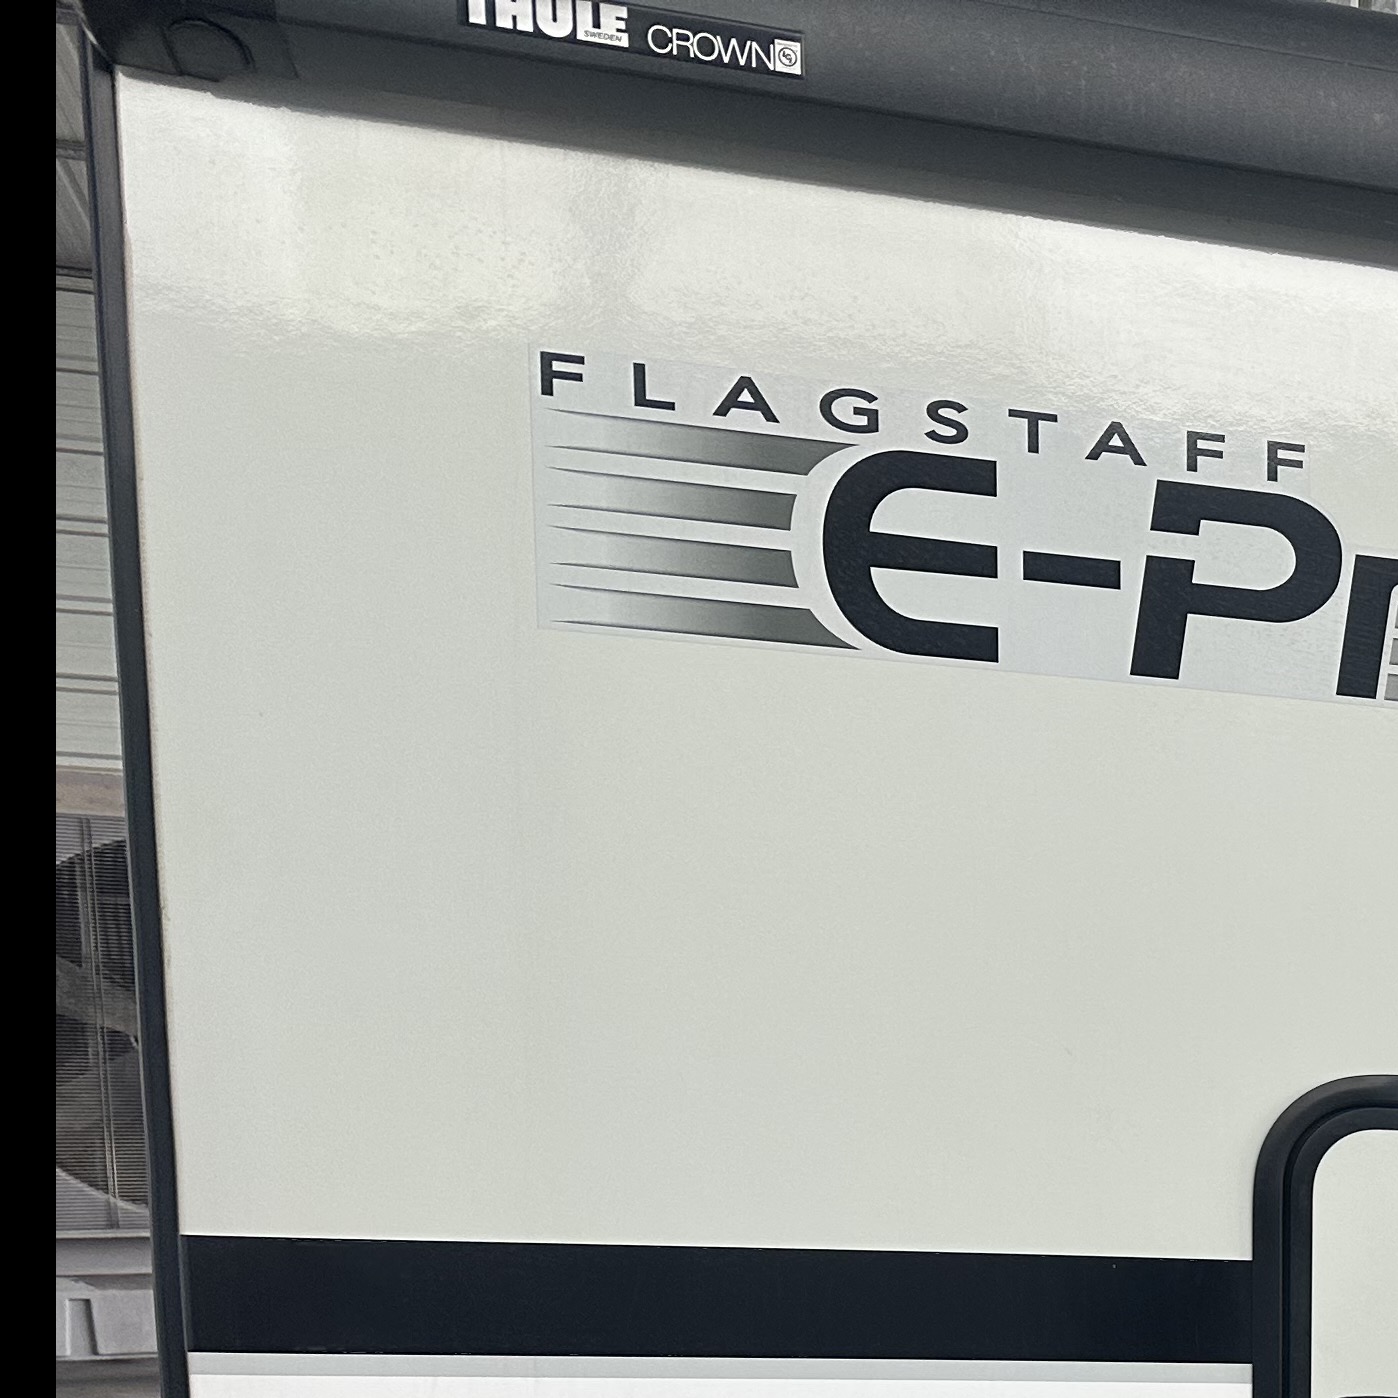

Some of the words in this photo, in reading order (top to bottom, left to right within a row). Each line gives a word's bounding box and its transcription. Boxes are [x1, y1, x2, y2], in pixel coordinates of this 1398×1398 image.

[584, 30, 622, 43] SWEDEN
[647, 24, 775, 71] CROWN
[538, 350, 1306, 484] FLAGSTAFF
